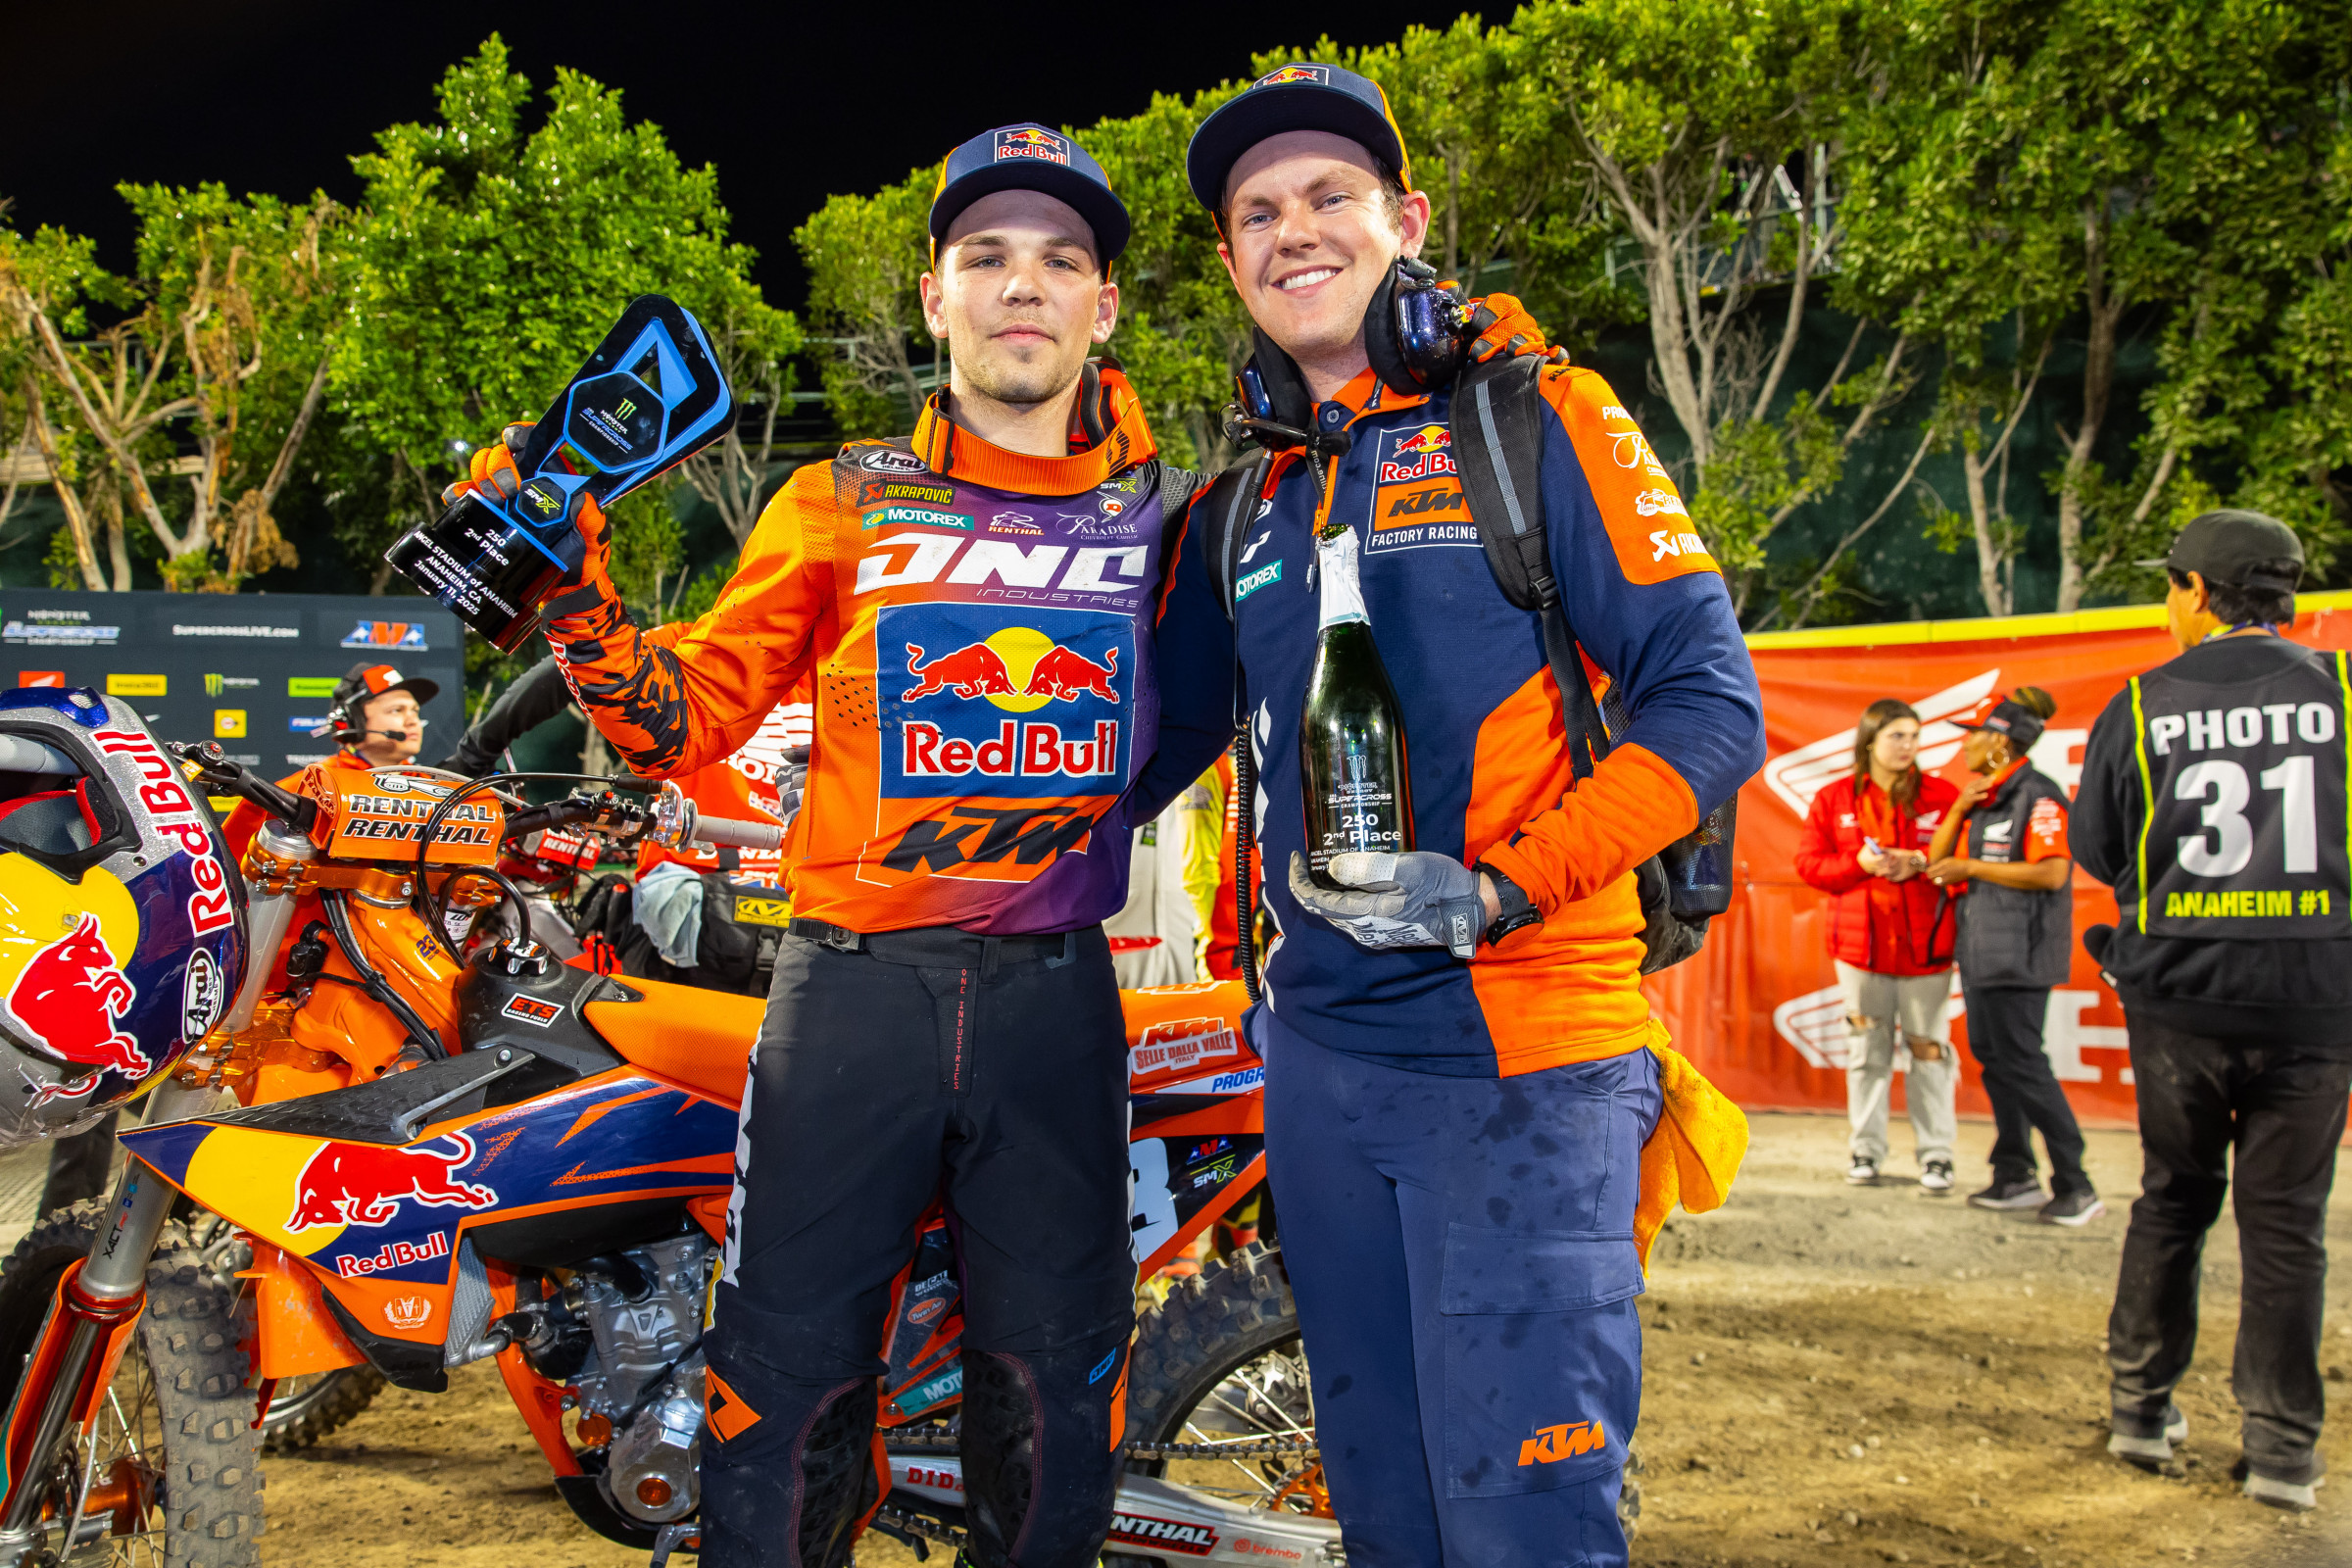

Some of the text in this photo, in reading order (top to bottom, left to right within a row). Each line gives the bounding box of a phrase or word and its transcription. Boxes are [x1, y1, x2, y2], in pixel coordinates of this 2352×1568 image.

[999, 144, 1066, 166] Red Bull
[1380, 453, 1457, 483] Red Bu
[524, 488, 557, 514] SMX
[1101, 481, 1137, 493] SMX
[1388, 487, 1464, 517] KTM
[888, 509, 965, 527] MOTOREX
[988, 525, 1045, 535] RENTHAL
[465, 527, 510, 566] 2nd Place
[485, 528, 507, 548] 250
[1372, 526, 1478, 547] FACTORY RACING
[414, 530, 518, 618] ANGEL STADIUM of ANAHEIM
[414, 560, 448, 590] January
[457, 596, 480, 615] 2025
[425, 556, 482, 605] ANAHEIM, CA
[1236, 563, 1279, 598] OTOREX
[976, 588, 1139, 609] INDUSTRIES
[2149, 702, 2336, 757] PHOTO
[903, 719, 1118, 777] Red Bull
[89, 729, 197, 816] Bull
[1328, 794, 1392, 804] SUPERCROSS
[1342, 813, 1379, 828] 250
[2174, 755, 2319, 878] 31
[880, 806, 1095, 873] KTM
[1323, 829, 1402, 846] 2nd Place
[154, 820, 234, 938] Red
[2165, 890, 2330, 918] ANAHEIM #1
[416, 934, 437, 958] 23
[506, 1008, 549, 1023] RACING FUELS
[512, 997, 557, 1019] ETS
[954, 1001, 964, 1090] INDUSTRIES
[1135, 1031, 1233, 1070] SELLE DALLA VALLE
[1175, 1054, 1196, 1064] ITALY
[1186, 1135, 1234, 1164] AMA
[1193, 1159, 1238, 1189] SMX
[102, 1224, 122, 1260] XACT
[335, 1230, 449, 1279] Red Bull
[911, 1299, 943, 1321] Twin Air
[923, 1369, 962, 1400] MOT
[1517, 1420, 1606, 1467] KTM
[906, 1467, 955, 1490] DID
[1112, 1514, 1213, 1546] NTHAL
[1252, 1544, 1301, 1560] brembo
